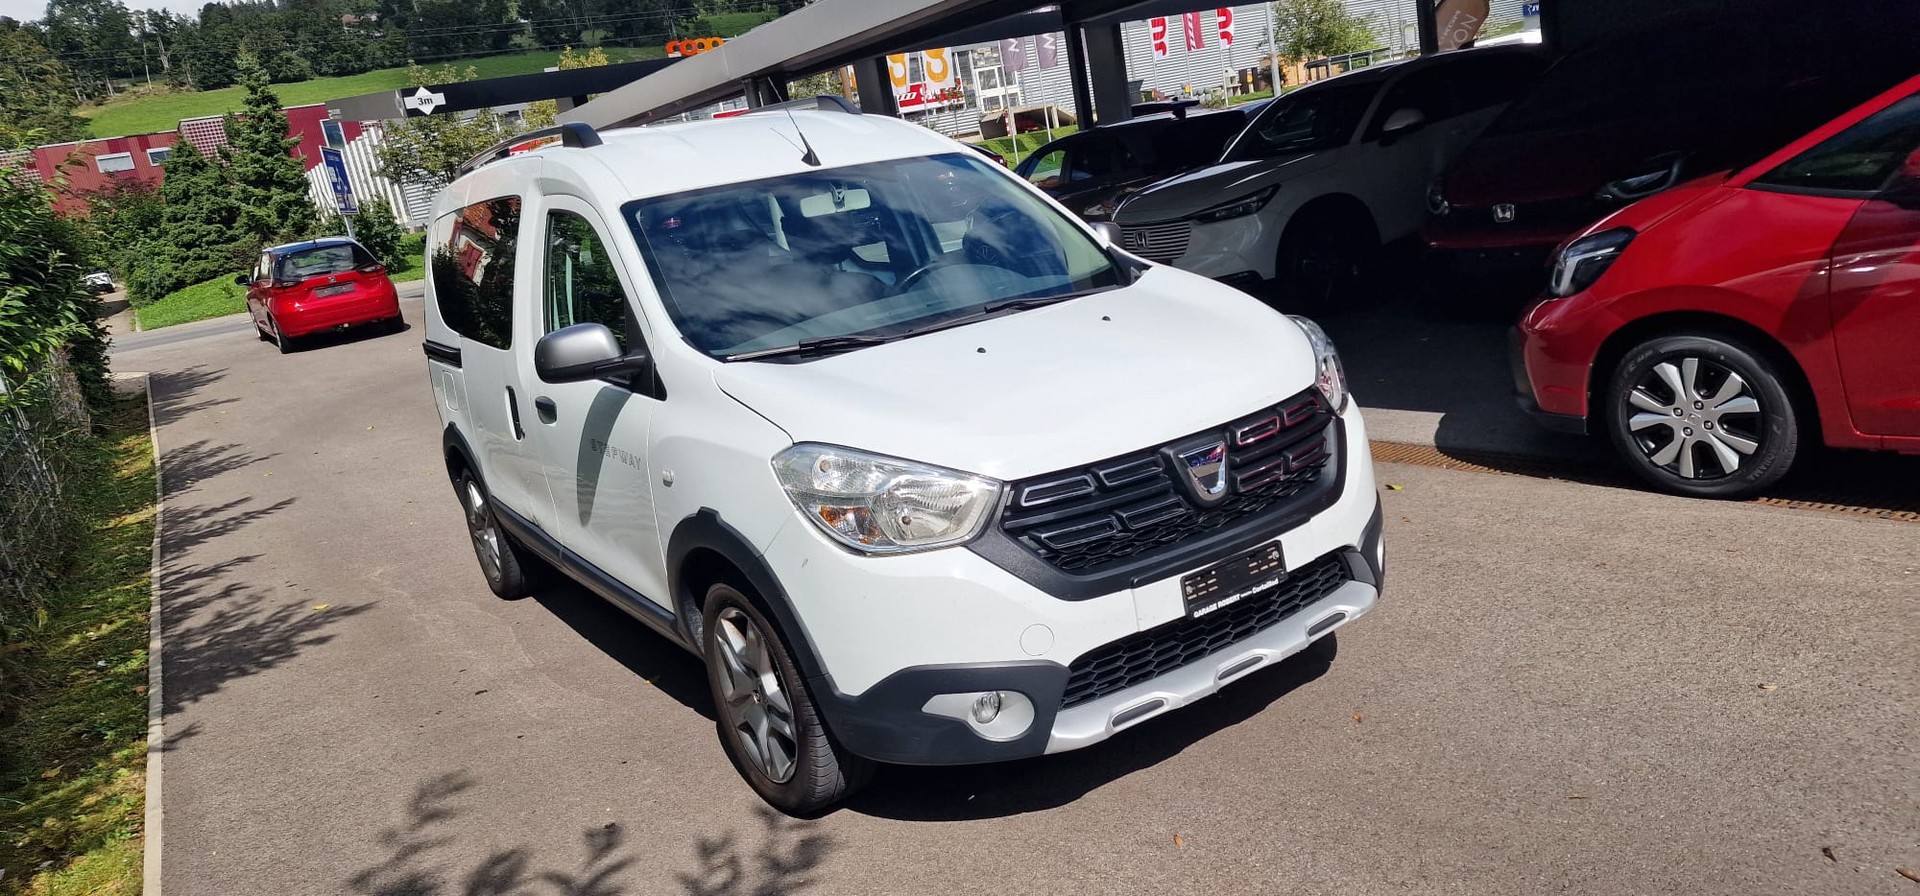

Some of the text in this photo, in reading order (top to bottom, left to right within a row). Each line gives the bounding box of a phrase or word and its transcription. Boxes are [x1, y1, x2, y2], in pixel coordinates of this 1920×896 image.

[417, 97, 433, 105] 3m
[591, 438, 641, 470] STEPWAY
[1193, 603, 1218, 618] GARAGE
[1218, 593, 1241, 608] ROBERT
